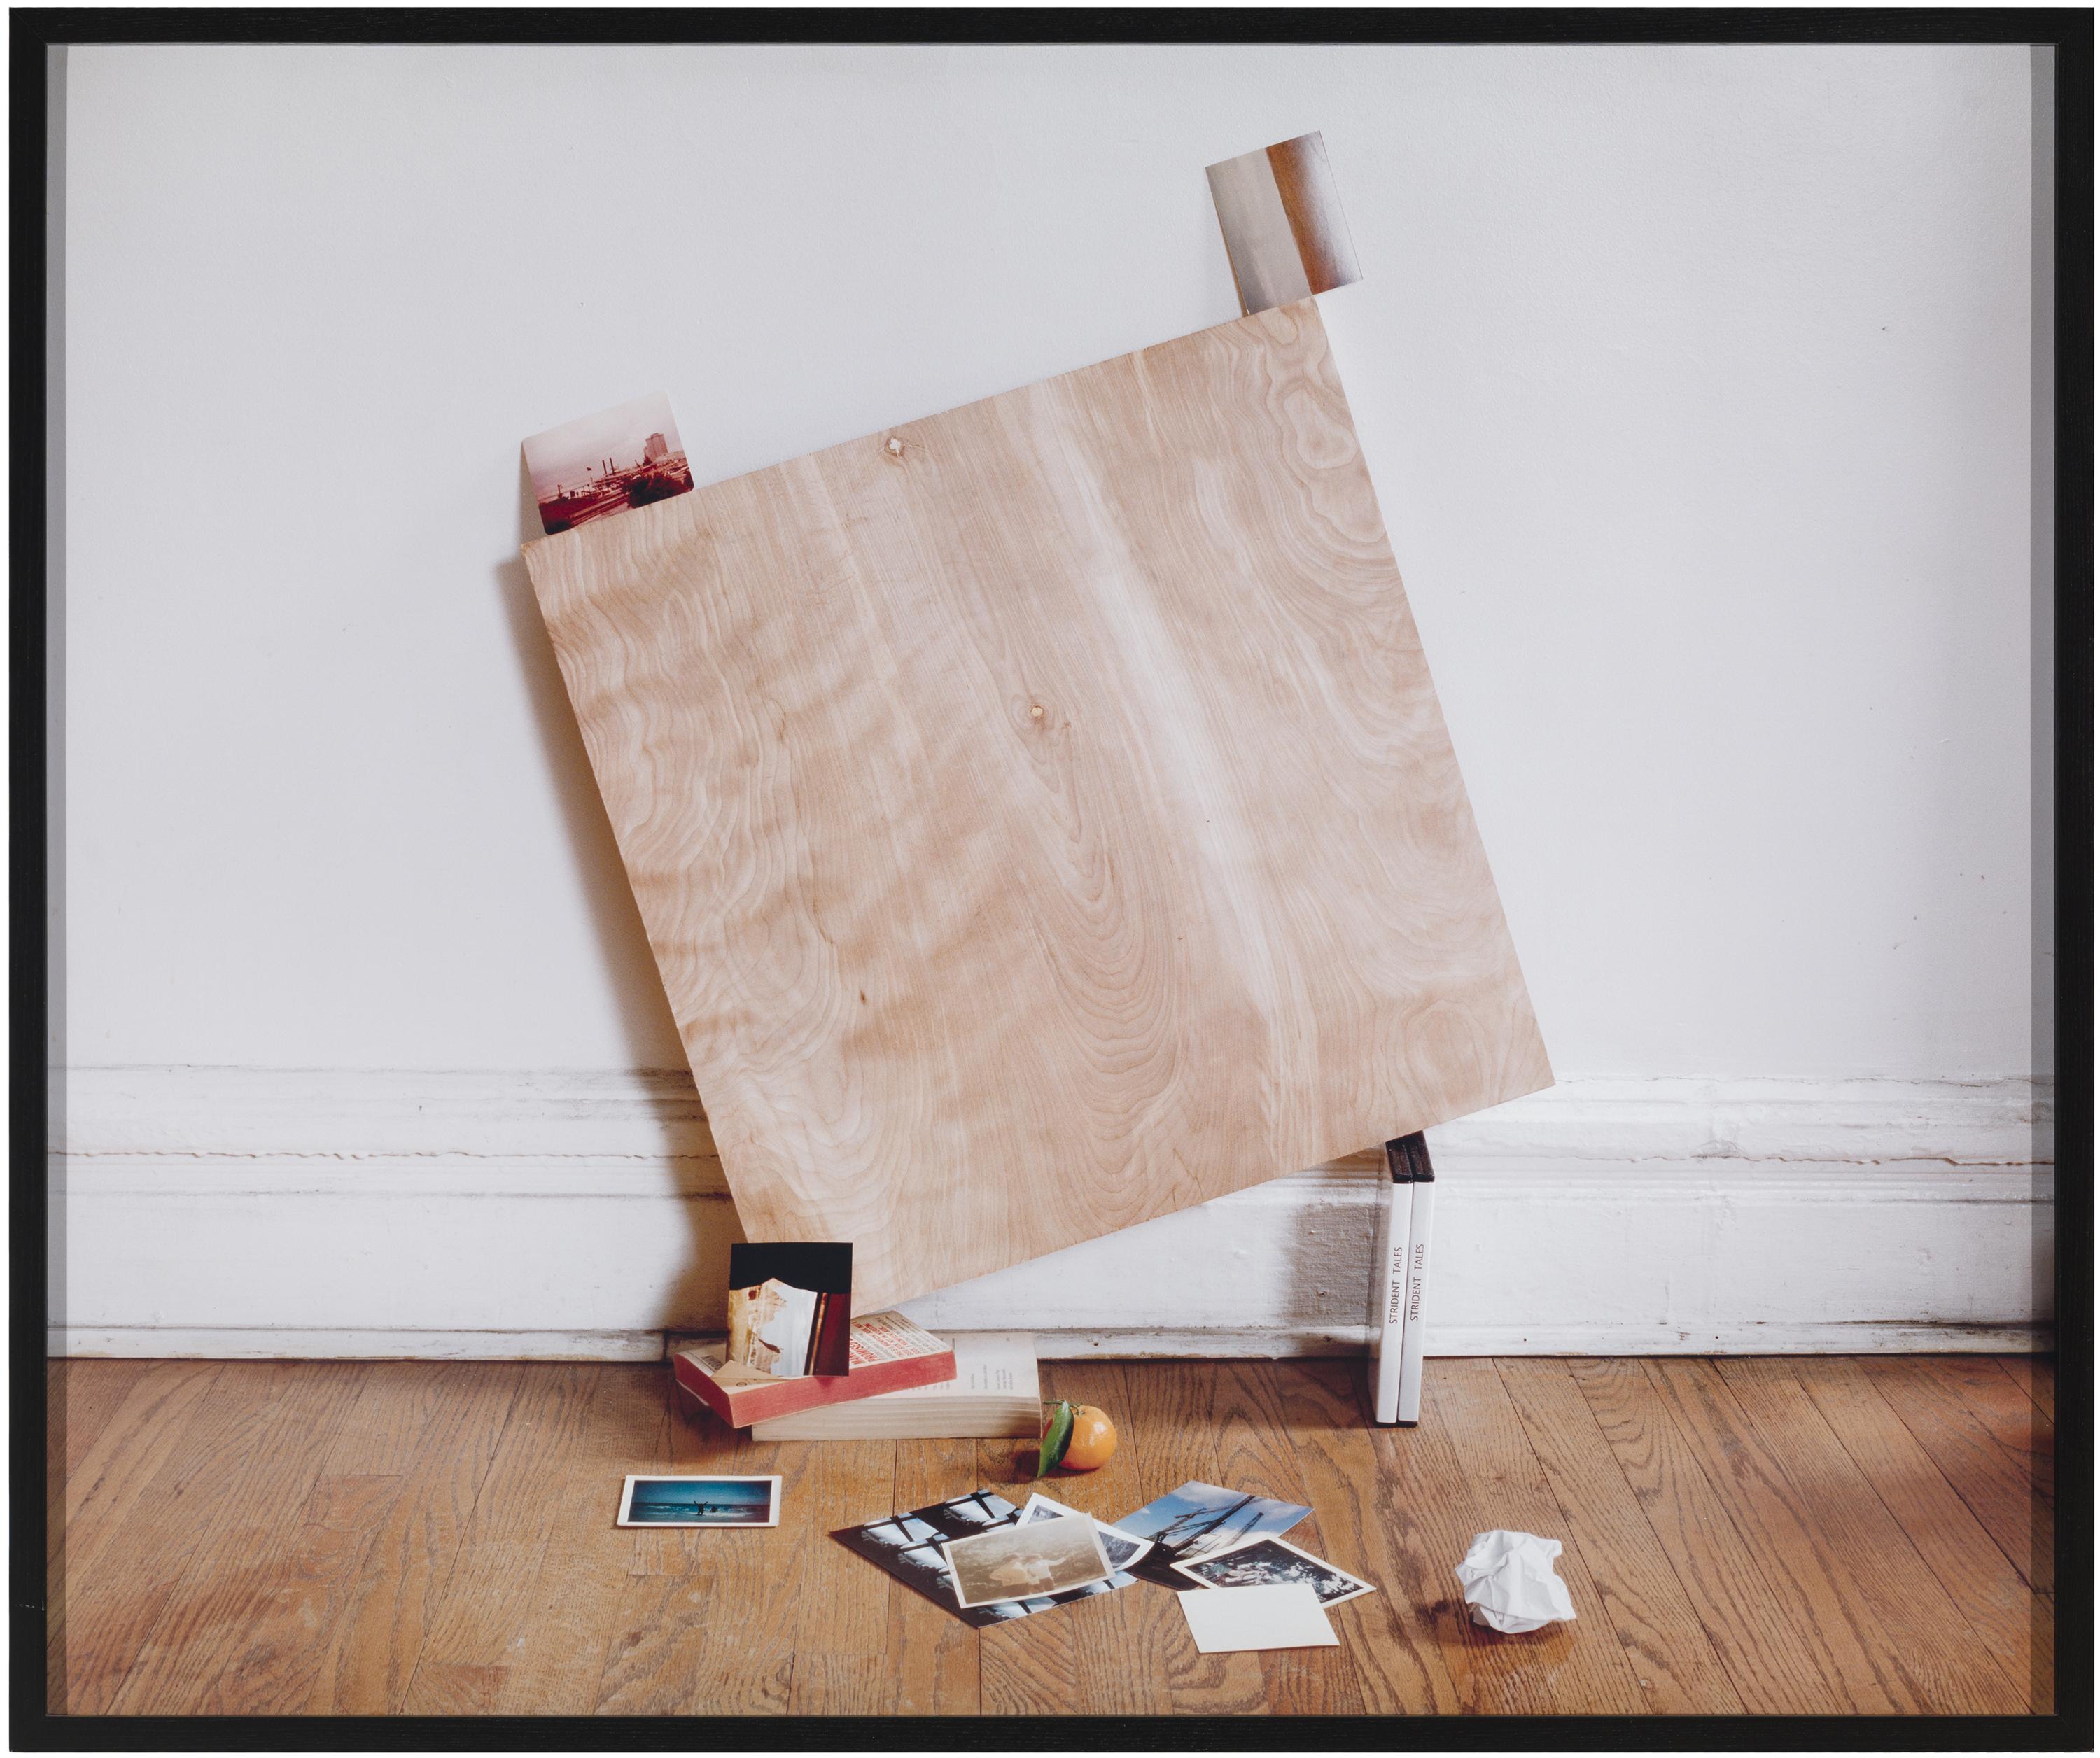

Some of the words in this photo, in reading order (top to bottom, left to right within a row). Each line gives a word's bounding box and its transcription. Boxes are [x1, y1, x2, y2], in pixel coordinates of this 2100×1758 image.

[1393, 1246, 1403, 1274] TALES
[1414, 1244, 1424, 1271] TALES
[1390, 1279, 1400, 1324] STRIDENT
[1410, 1276, 1422, 1321] STRIDENT
